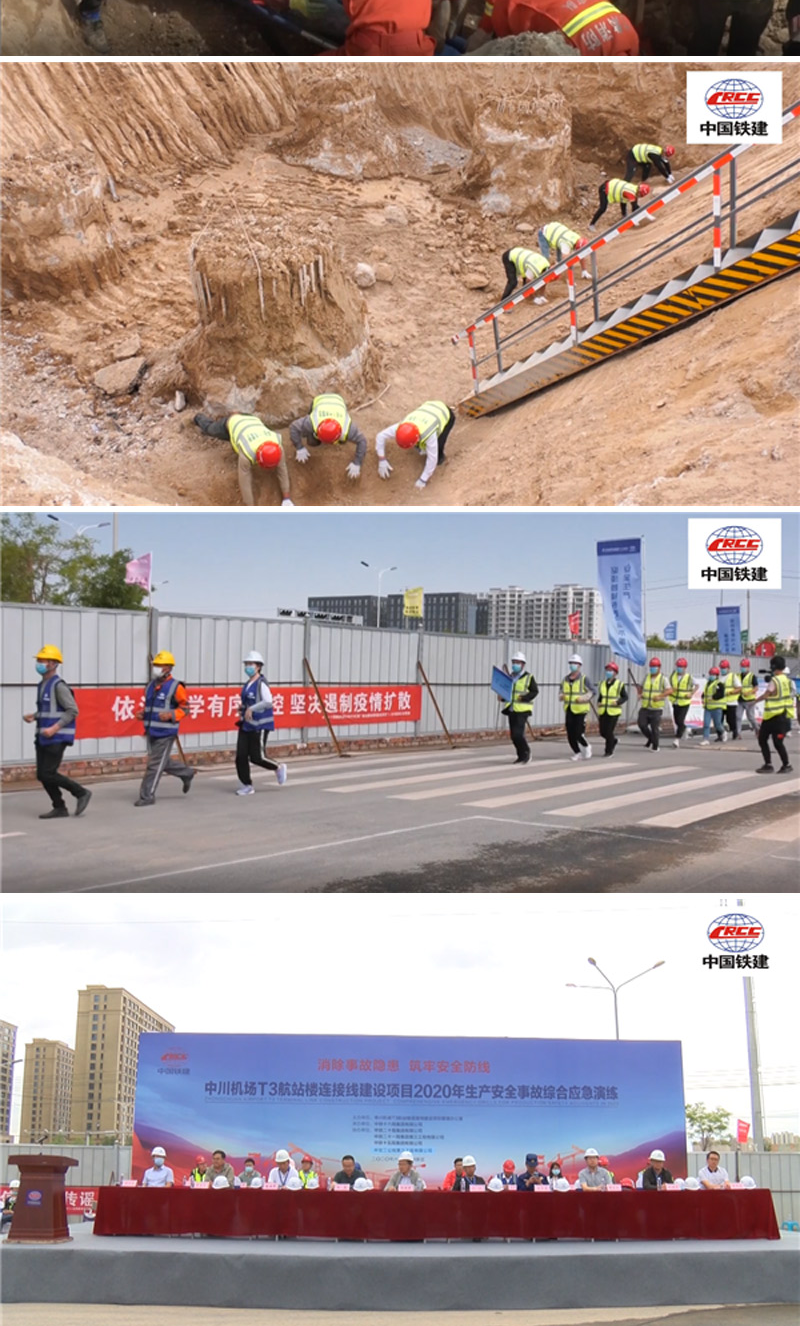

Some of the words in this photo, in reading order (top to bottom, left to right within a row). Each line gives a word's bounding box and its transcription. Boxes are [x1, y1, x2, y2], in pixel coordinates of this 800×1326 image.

[290, 691, 411, 715] 坚决遏制疫情扩散
[317, 1059, 399, 1072] 消除事故隐患
[409, 1059, 491, 1074] 筑牢安全防线
[204, 1080, 619, 1101] 中川机场T3航站楼连接线建设项目2020年生产安全事故综合应急演练
